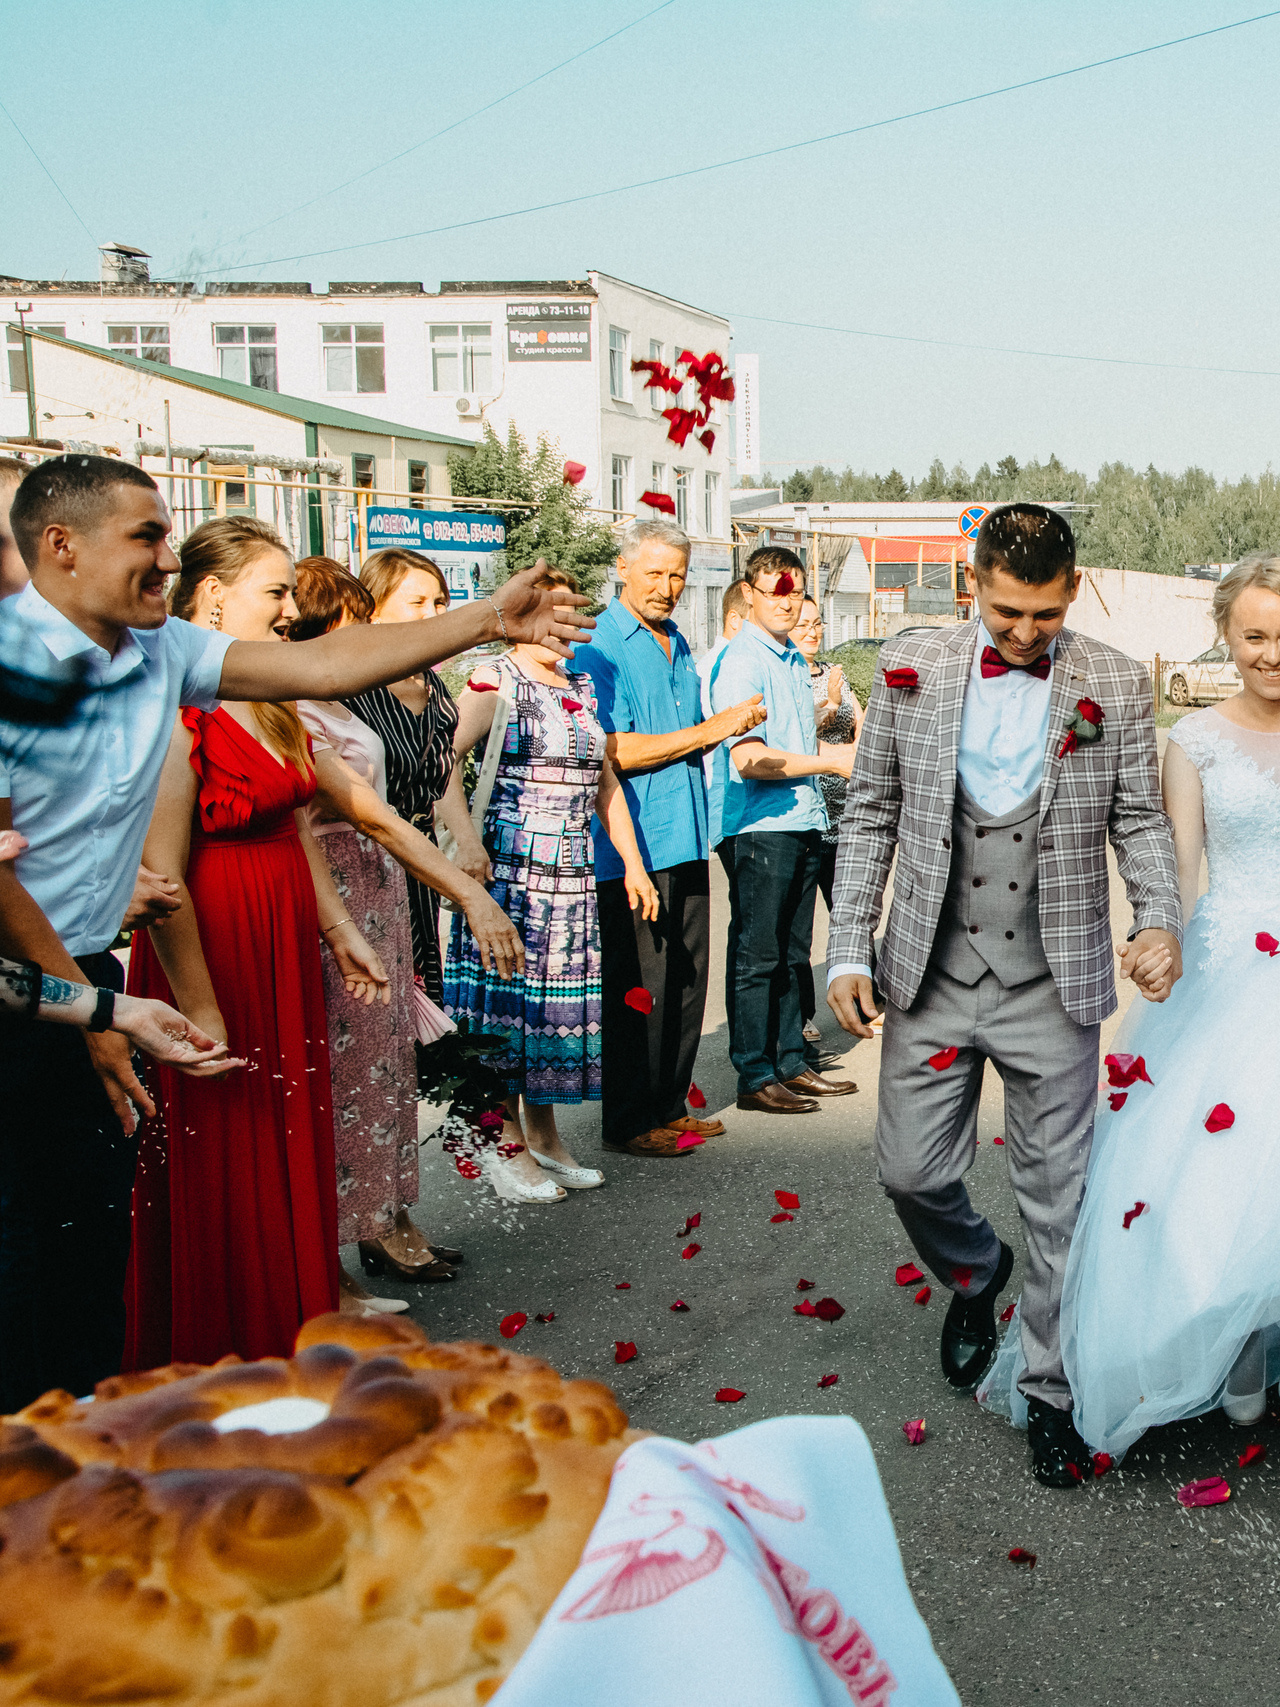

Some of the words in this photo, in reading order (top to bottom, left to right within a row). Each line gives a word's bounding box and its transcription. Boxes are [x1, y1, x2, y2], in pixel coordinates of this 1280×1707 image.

[508, 306, 540, 316] АРЕНДА
[549, 306, 589, 315] 73-11-10
[470, 523, 505, 544] 55-94-40
